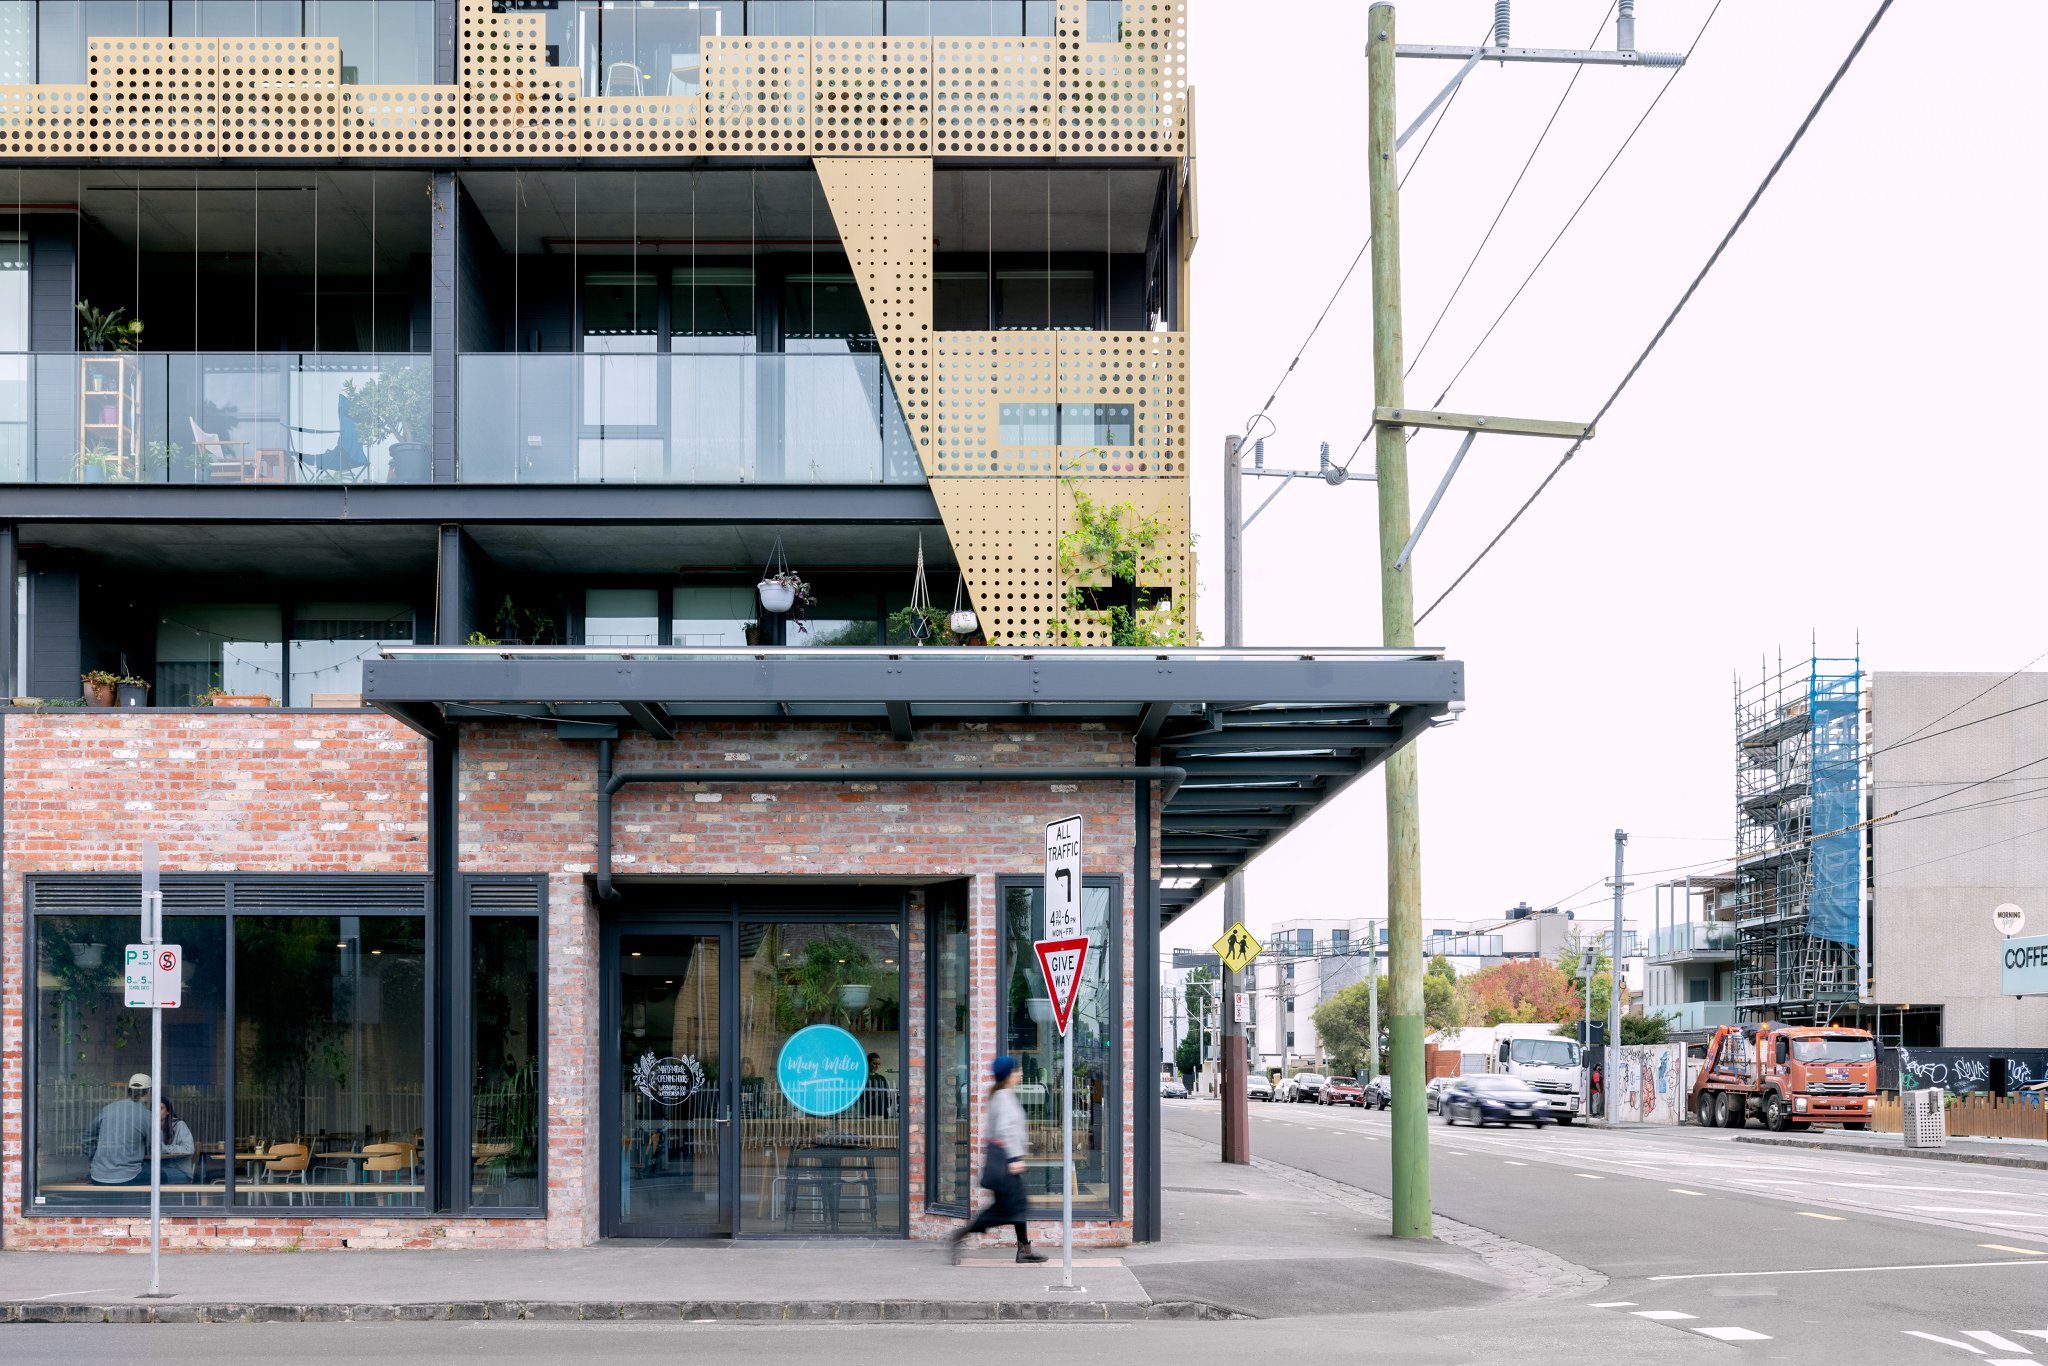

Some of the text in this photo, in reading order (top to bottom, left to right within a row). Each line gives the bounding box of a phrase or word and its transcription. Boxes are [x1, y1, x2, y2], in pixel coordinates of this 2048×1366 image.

[1056, 824, 1071, 841] ALL
[1048, 841, 1079, 862] TRAFFIC
[1050, 911, 1055, 926] 4
[1064, 909, 1070, 924] 6
[1997, 911, 2021, 919] MORNING
[127, 950, 149, 965] P 5
[1051, 955, 1075, 971] GIVE
[2004, 945, 2048, 969] COFFE
[126, 975, 132, 984] 8
[141, 975, 147, 984] 5
[1055, 974, 1072, 987] WAY
[784, 1054, 860, 1079] Mary Miller
